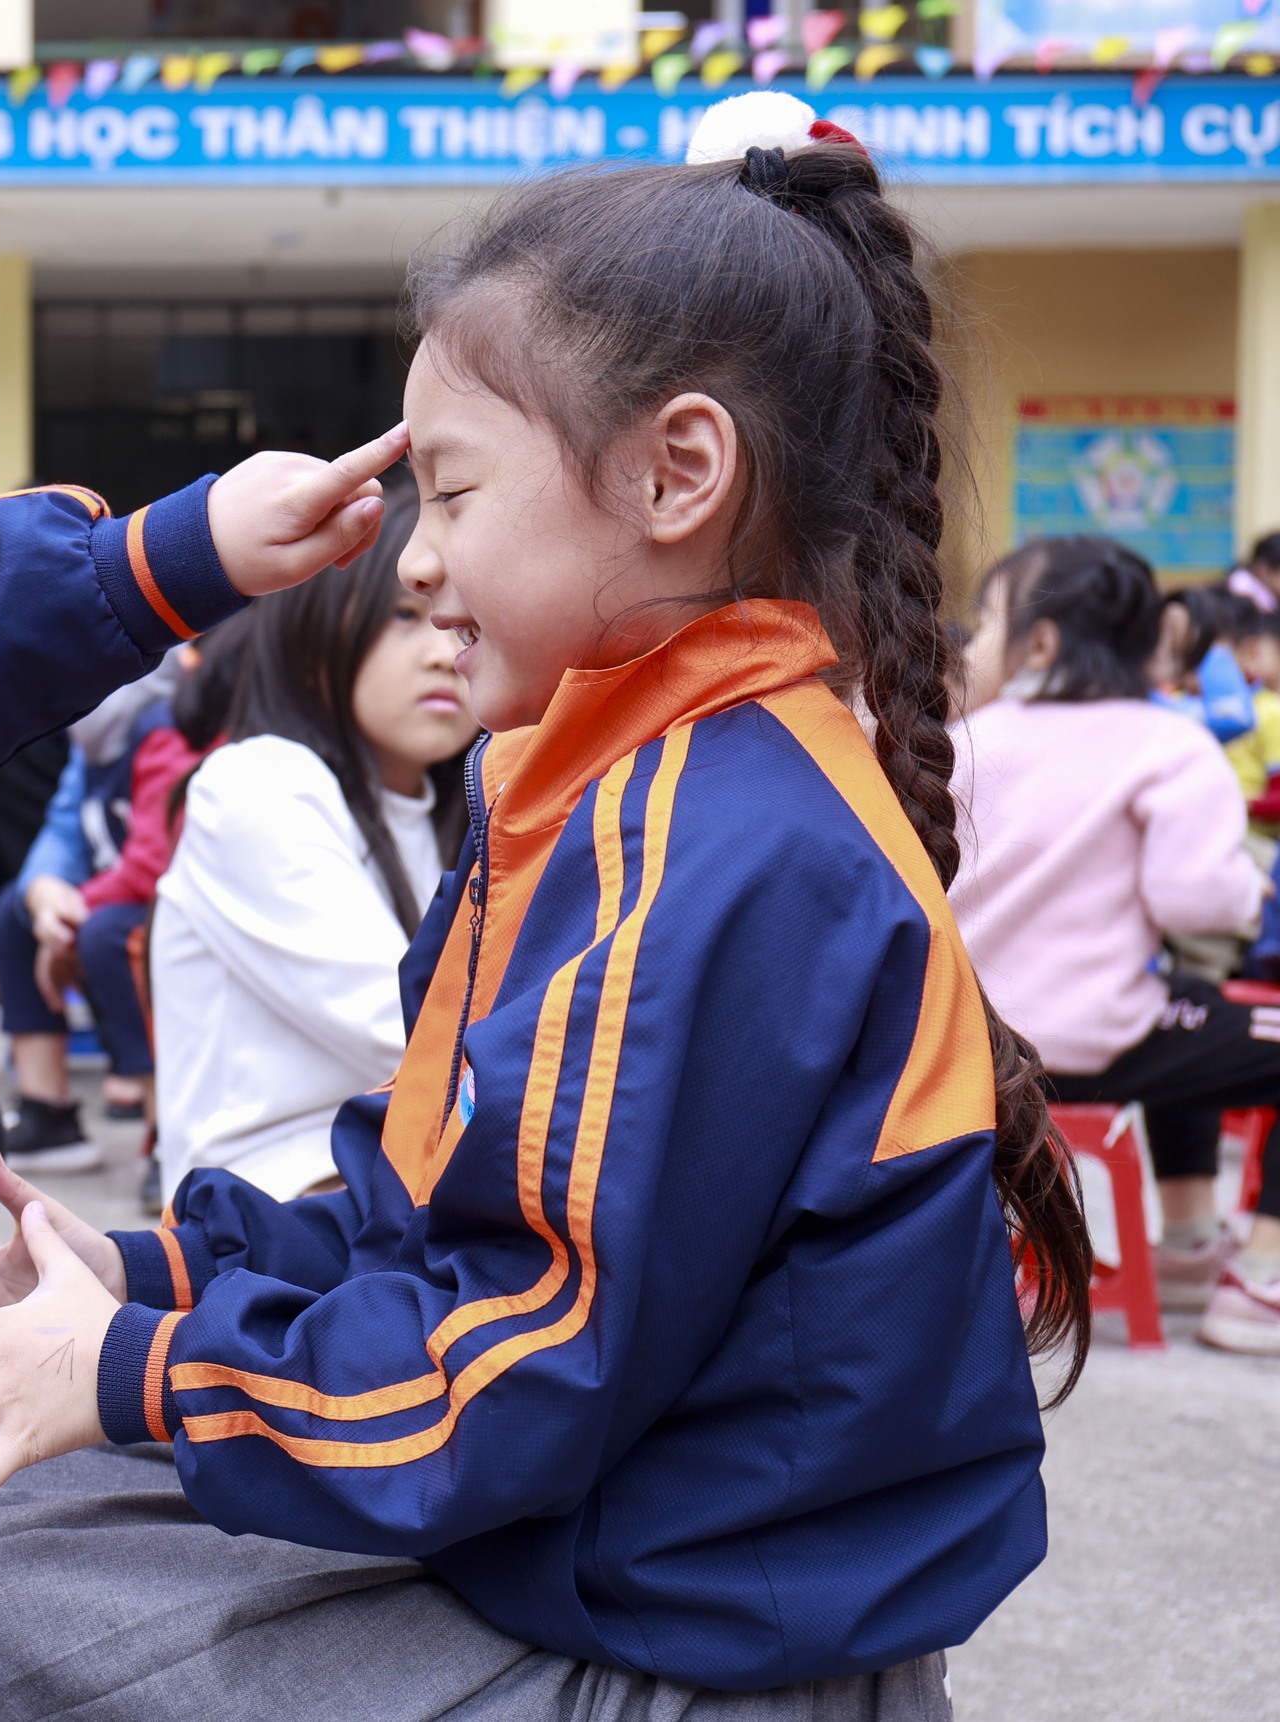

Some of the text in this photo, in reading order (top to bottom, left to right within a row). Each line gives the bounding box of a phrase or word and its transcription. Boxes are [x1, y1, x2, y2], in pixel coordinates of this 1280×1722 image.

[28, 105, 179, 170] HỌC
[191, 95, 387, 159] THÂN
[397, 95, 607, 168] THIỆN
[1003, 91, 1166, 158] TÍCH
